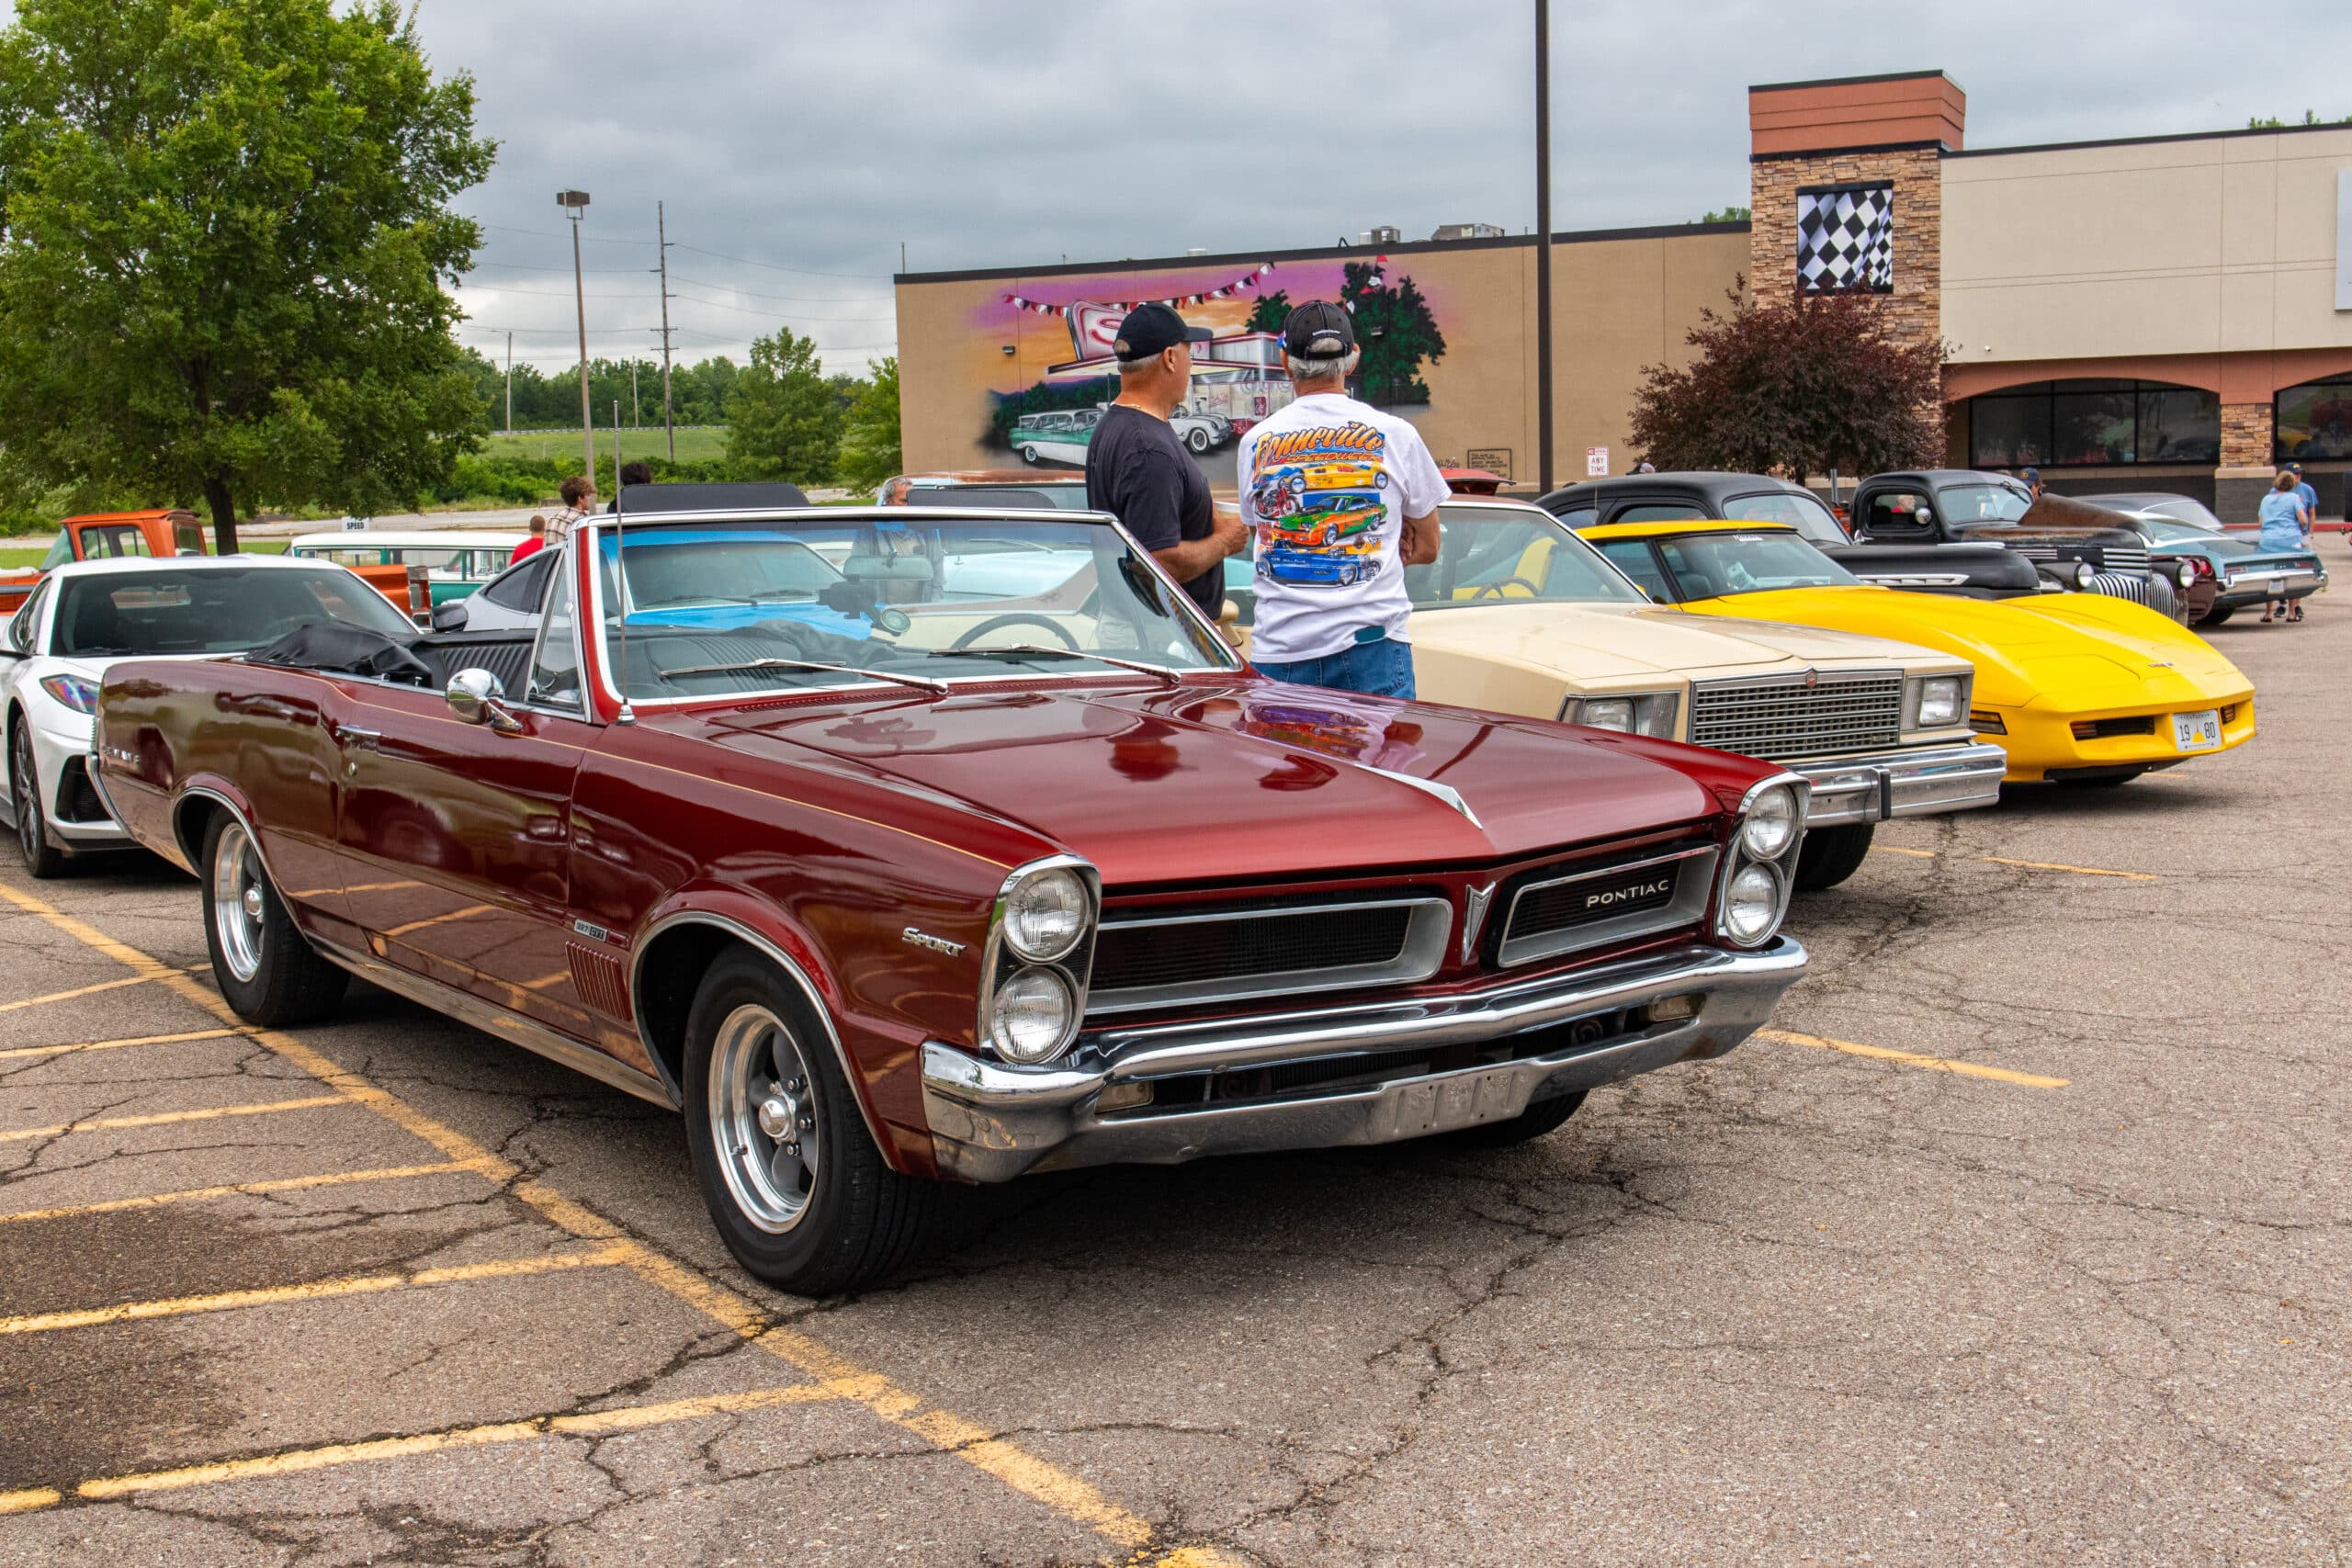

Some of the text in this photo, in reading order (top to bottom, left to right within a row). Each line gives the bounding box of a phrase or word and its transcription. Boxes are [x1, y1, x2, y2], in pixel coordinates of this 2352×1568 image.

[1252, 421, 1384, 482] Bonneville
[1590, 465, 1606, 473] TIME
[346, 521, 365, 530] SPEED
[2179, 721, 2216, 742] 19 80
[1587, 879, 1669, 908] PONTIAC
